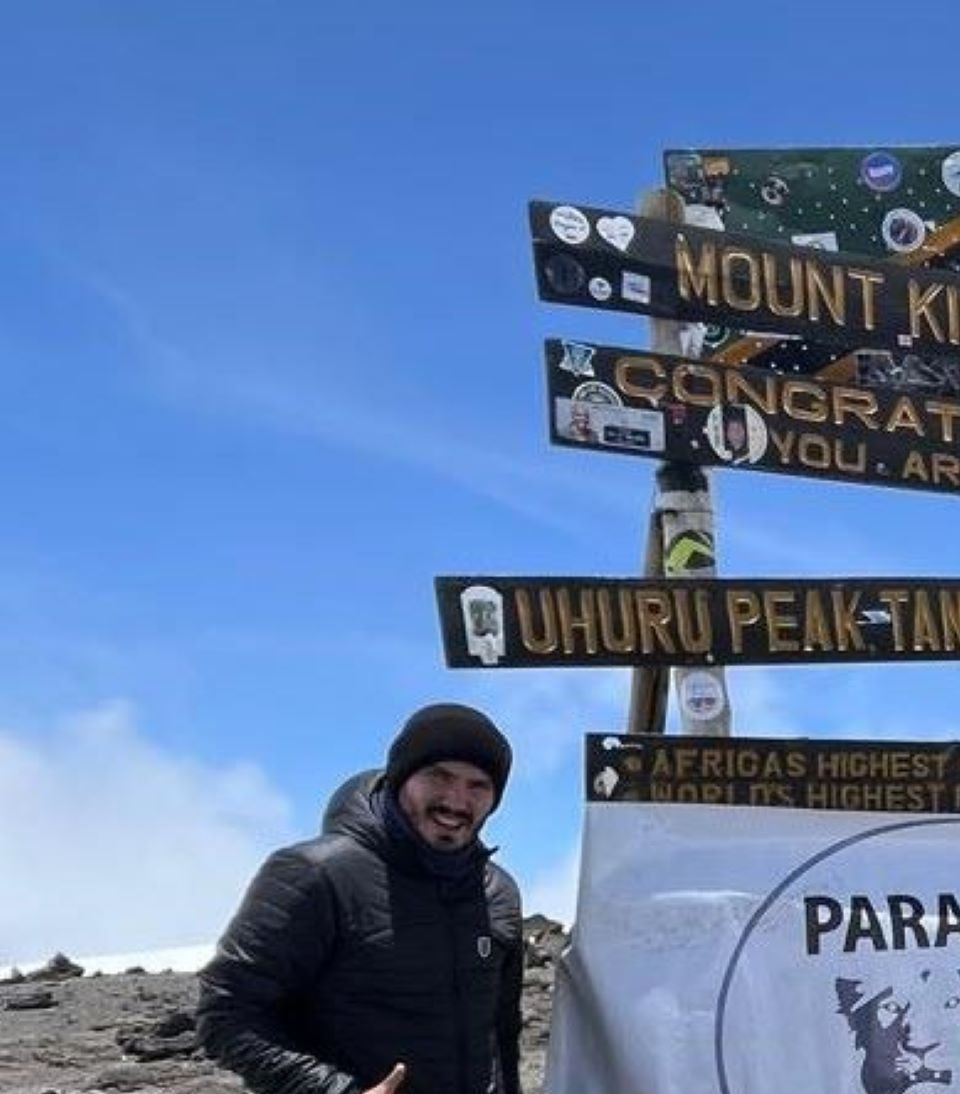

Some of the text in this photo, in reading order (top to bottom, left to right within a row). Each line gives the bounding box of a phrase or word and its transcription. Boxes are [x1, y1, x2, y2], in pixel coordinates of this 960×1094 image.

[675, 232, 885, 332] MOUNT
[768, 431, 867, 470] YOU
[514, 586, 713, 655] UHURU
[817, 751, 951, 780] HIGHEST
[808, 783, 946, 813] HIGHEST
